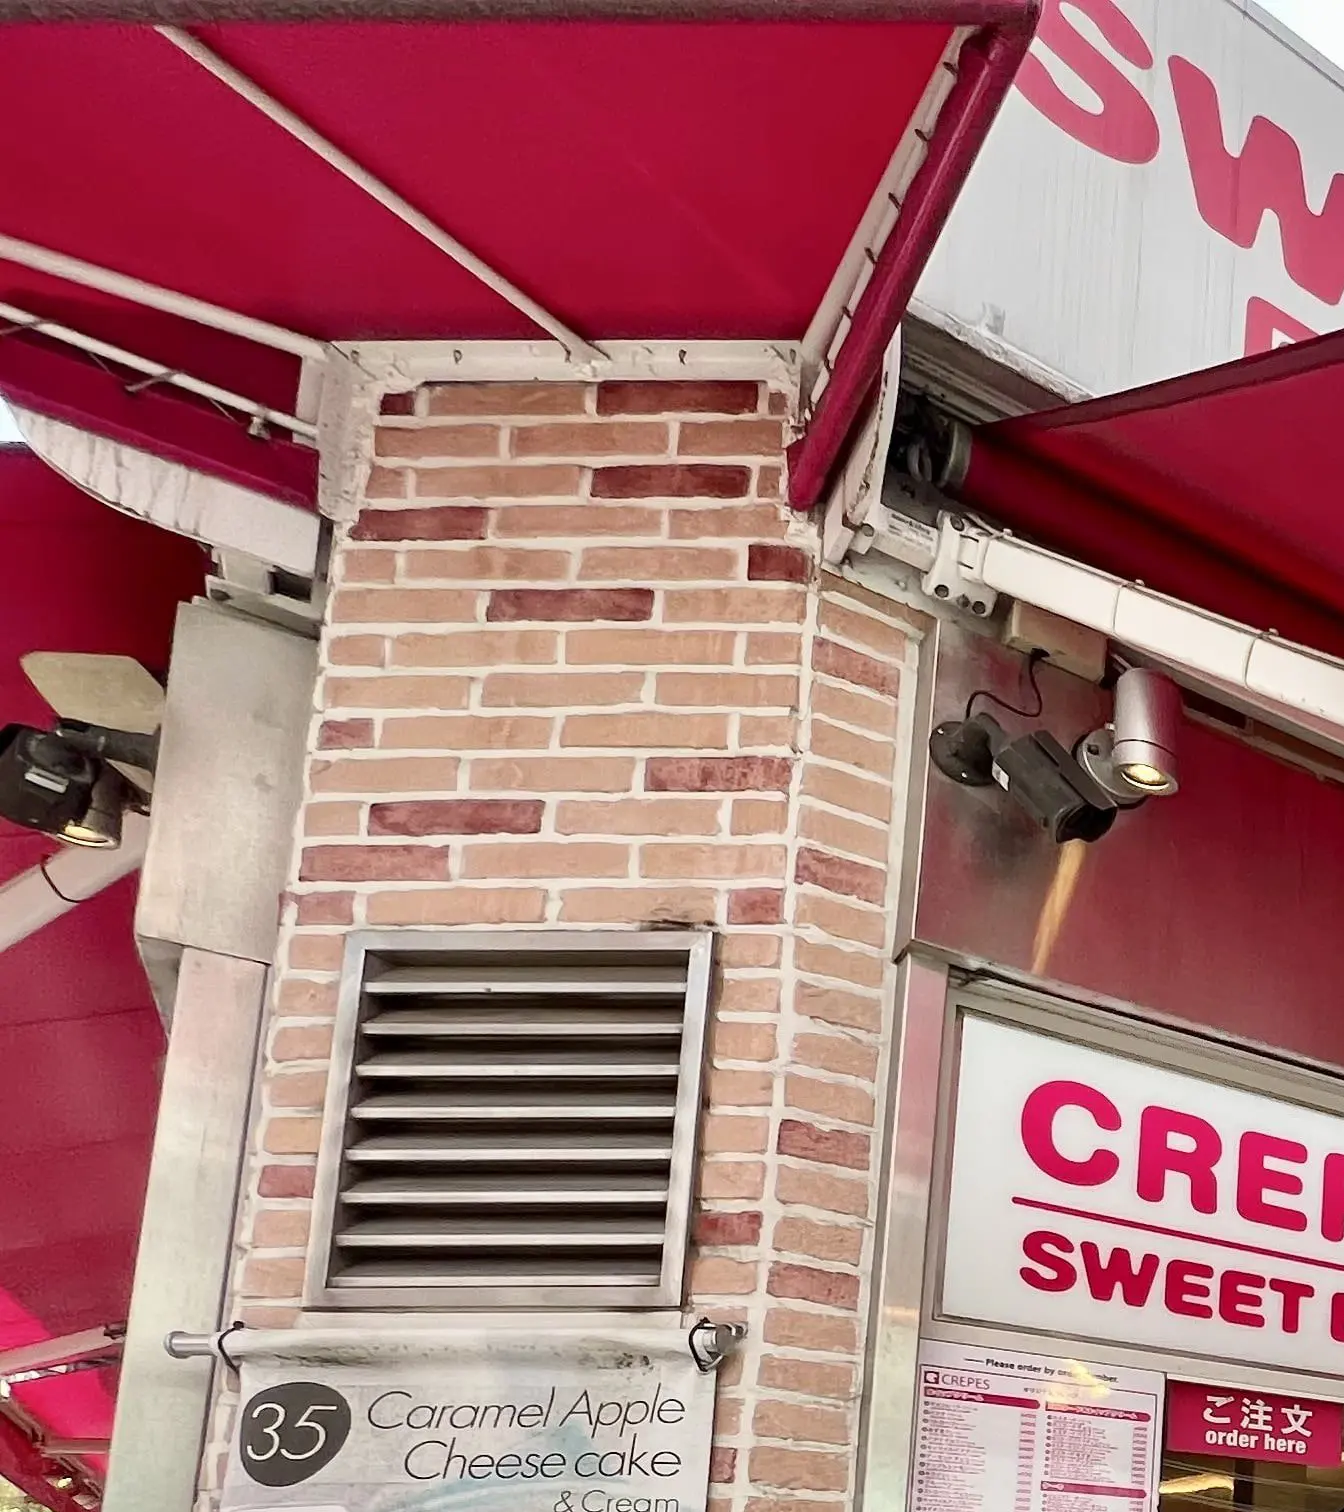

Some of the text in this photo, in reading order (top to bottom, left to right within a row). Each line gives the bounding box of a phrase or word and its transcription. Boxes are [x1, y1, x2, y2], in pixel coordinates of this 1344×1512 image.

[1019, 1229, 1315, 1337] SWEET
[942, 1373, 991, 1390] CREPES
[246, 1402, 337, 1464] 35
[367, 1387, 686, 1436] Caramel Apple
[1203, 1395, 1313, 1438] ご注文
[404, 1438, 682, 1481] Cheese cake
[1205, 1429, 1307, 1454] order here
